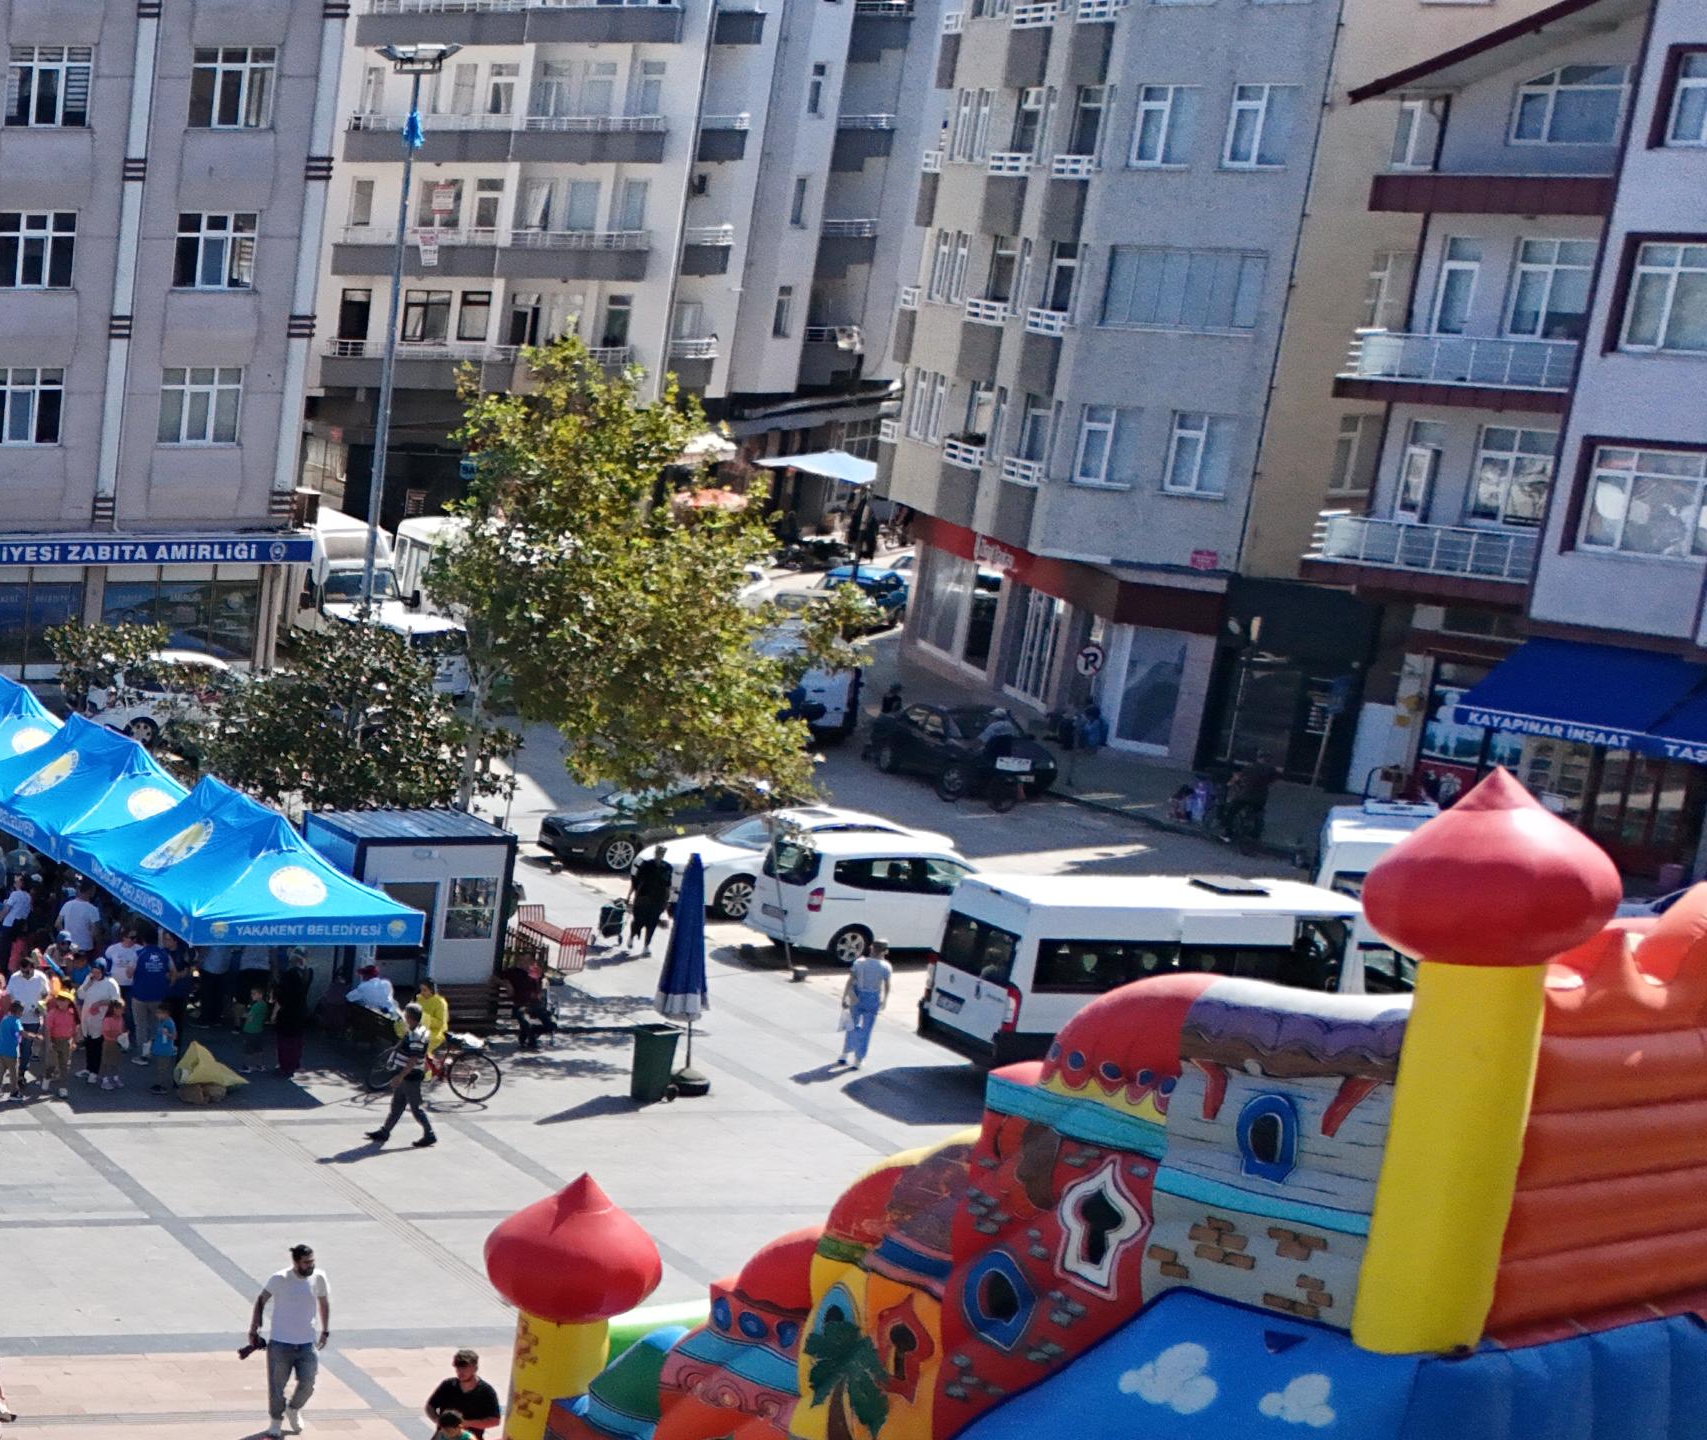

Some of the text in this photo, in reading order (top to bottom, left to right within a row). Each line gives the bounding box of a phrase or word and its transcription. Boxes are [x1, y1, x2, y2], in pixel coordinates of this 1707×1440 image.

[67, 545, 148, 561] ZABITA
[155, 542, 257, 560] AMİRLİĞİ
[1468, 711, 1563, 737] KAYAPINAR
[1567, 725, 1631, 748] İNŞAAT
[236, 923, 381, 936] YAKAKENT BELEDİYESİ
